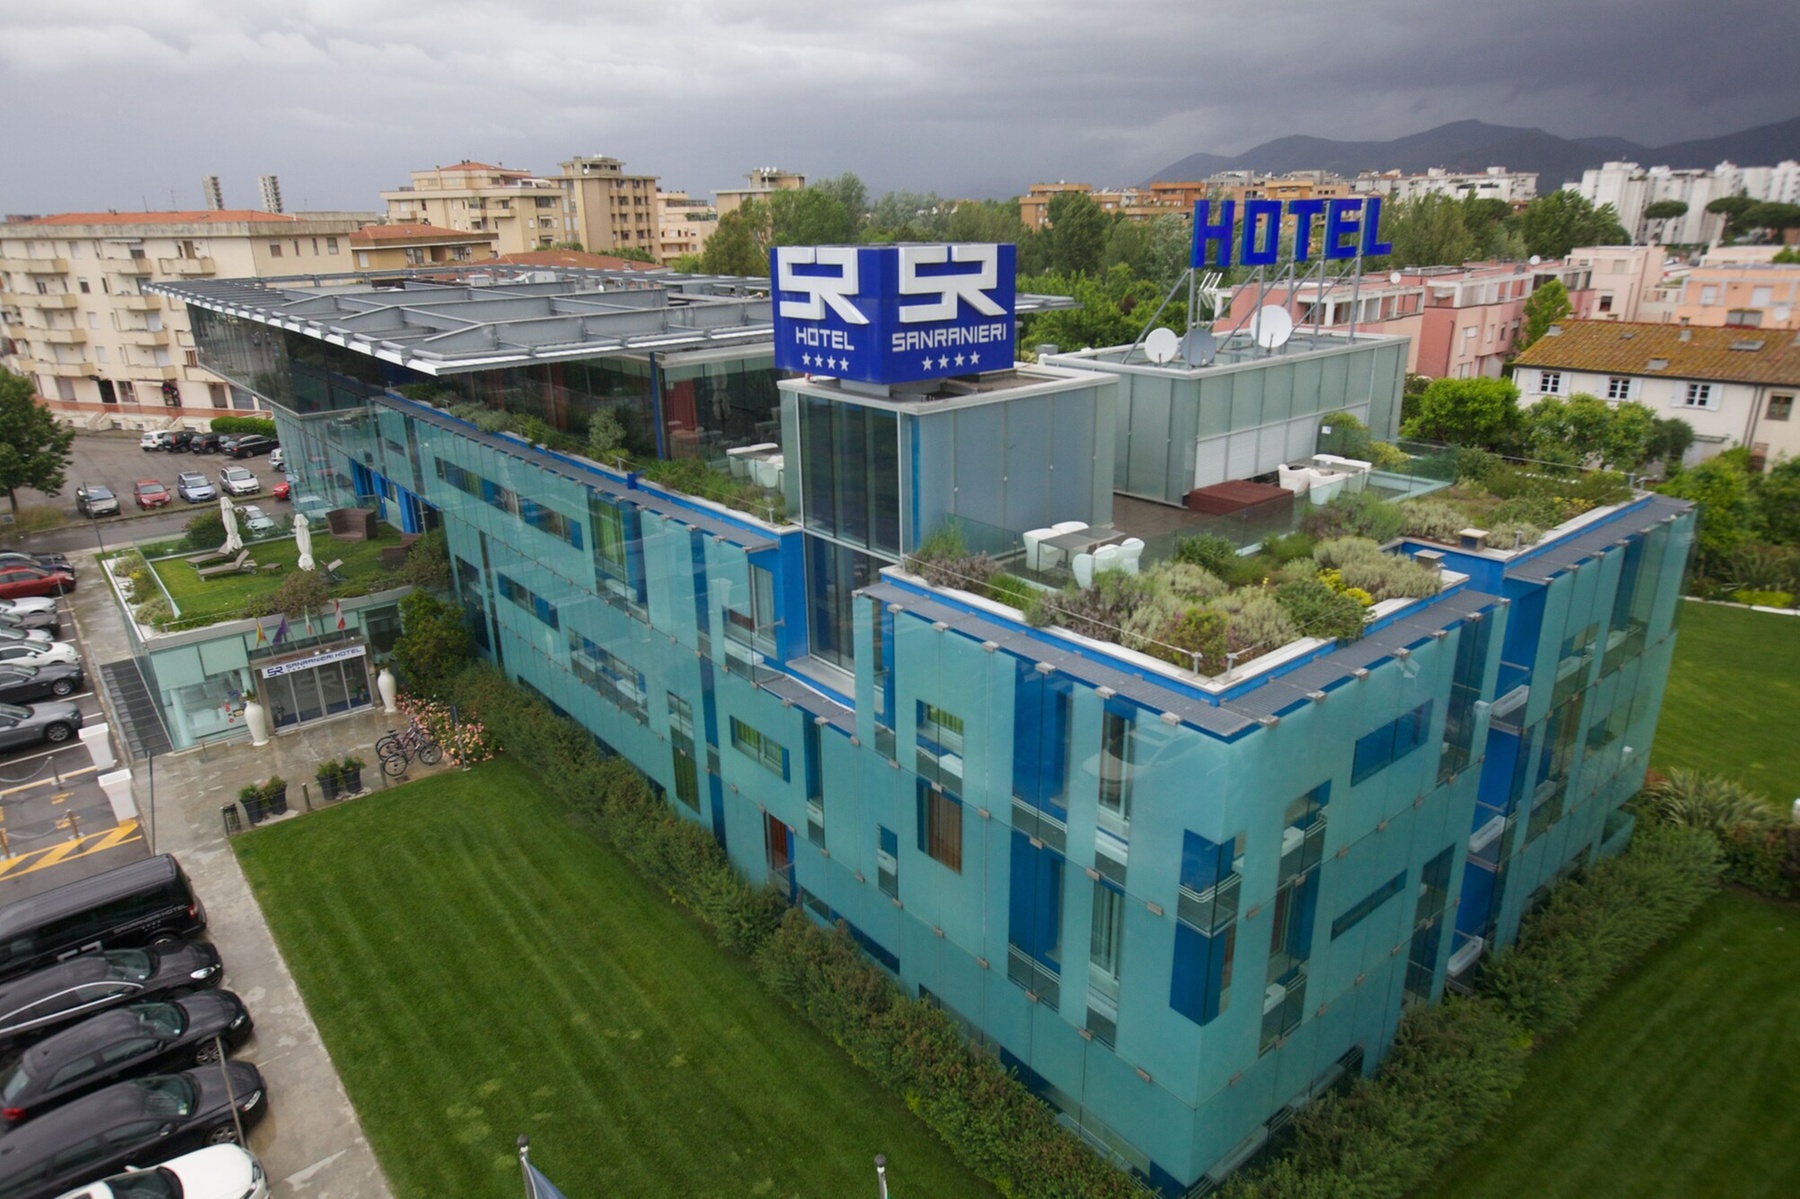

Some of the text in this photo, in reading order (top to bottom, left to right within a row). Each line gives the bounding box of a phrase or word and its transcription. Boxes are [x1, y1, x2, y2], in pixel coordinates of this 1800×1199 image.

[1190, 197, 1392, 269] HOTEL
[777, 246, 870, 325] SR
[898, 243, 1008, 324] SR
[795, 326, 855, 351] HOTEL
[892, 323, 1007, 353] SANRANIERI
[267, 648, 362, 677] SR SANRANIERI HOTEL
[162, 904, 189, 917] HOTEL
